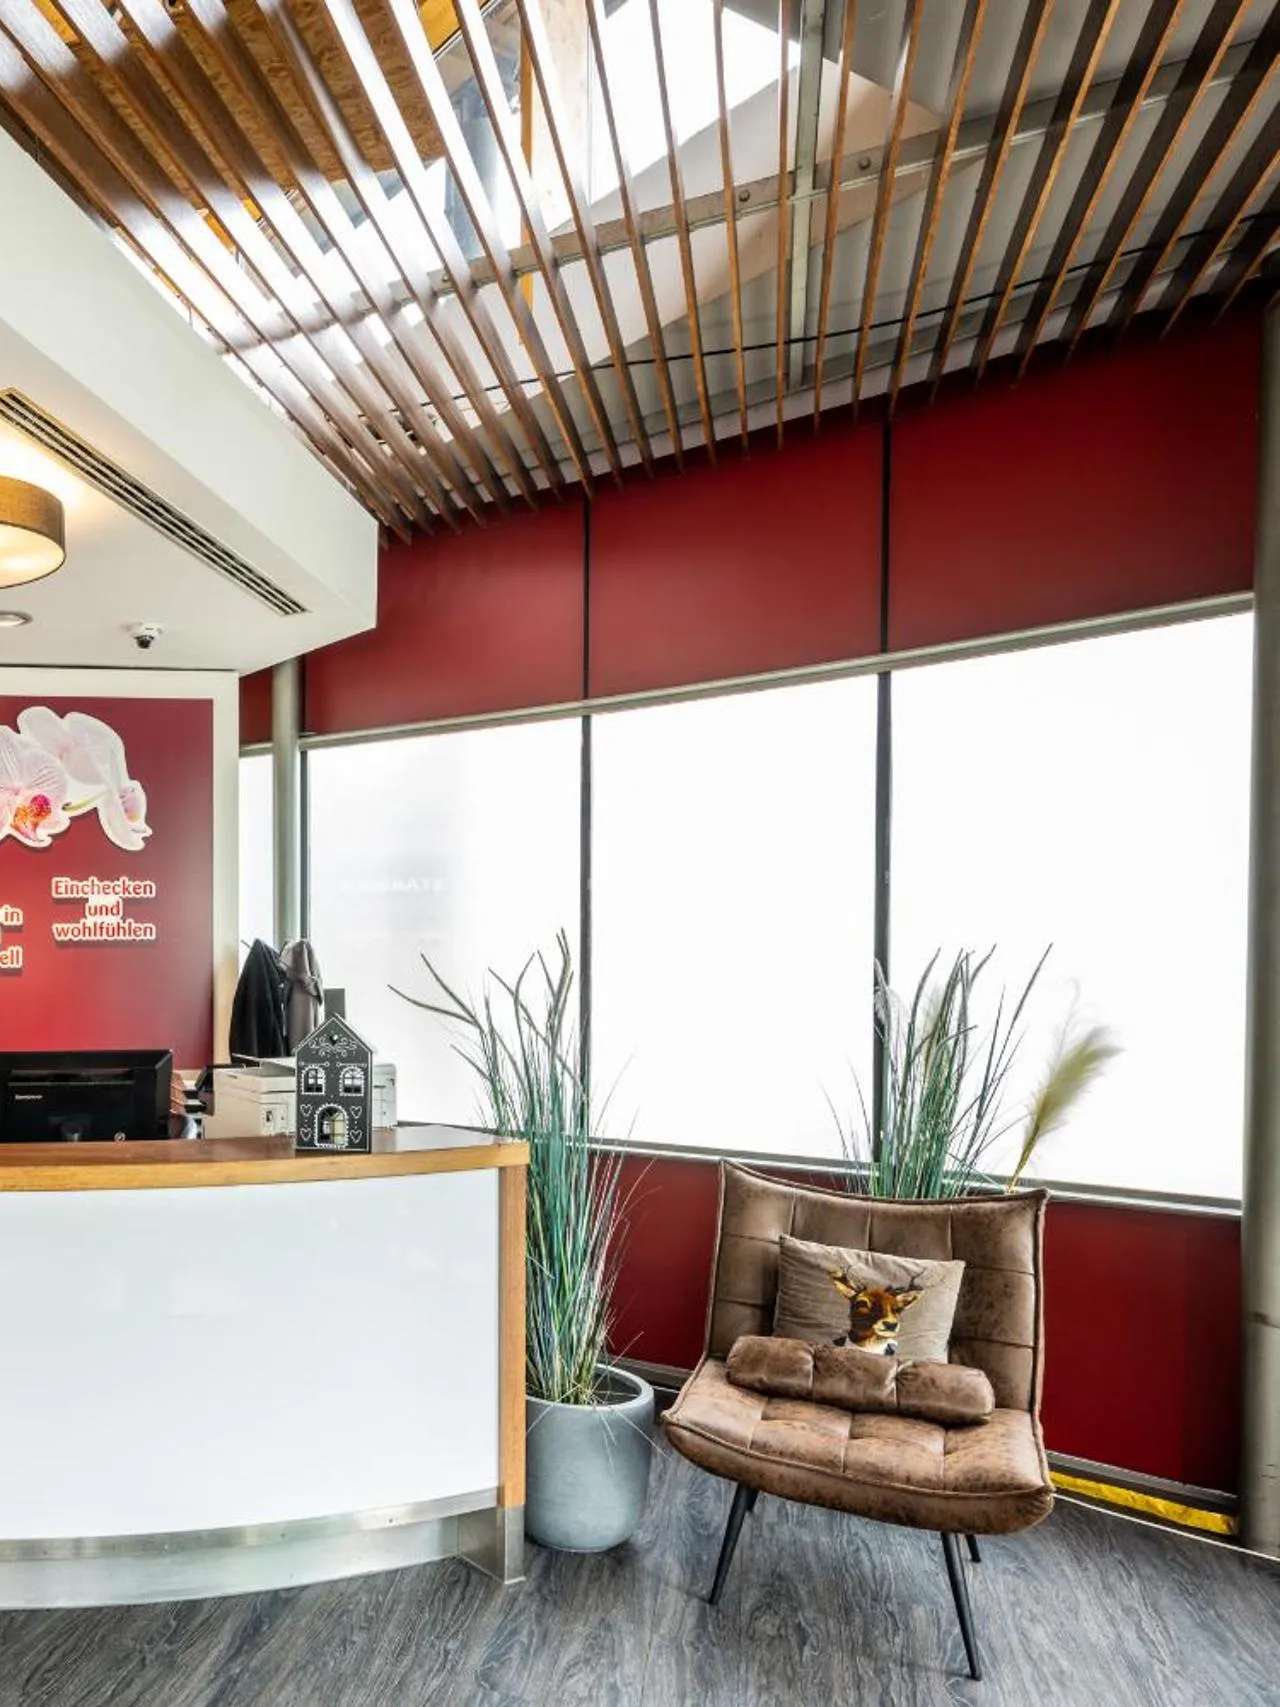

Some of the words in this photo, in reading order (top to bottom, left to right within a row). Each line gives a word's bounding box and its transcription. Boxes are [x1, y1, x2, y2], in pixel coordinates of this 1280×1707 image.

[54, 878, 153, 896] Einchecken
[4, 906, 21, 922] in
[88, 901, 120, 917] und
[54, 921, 153, 938] wohlfühlen
